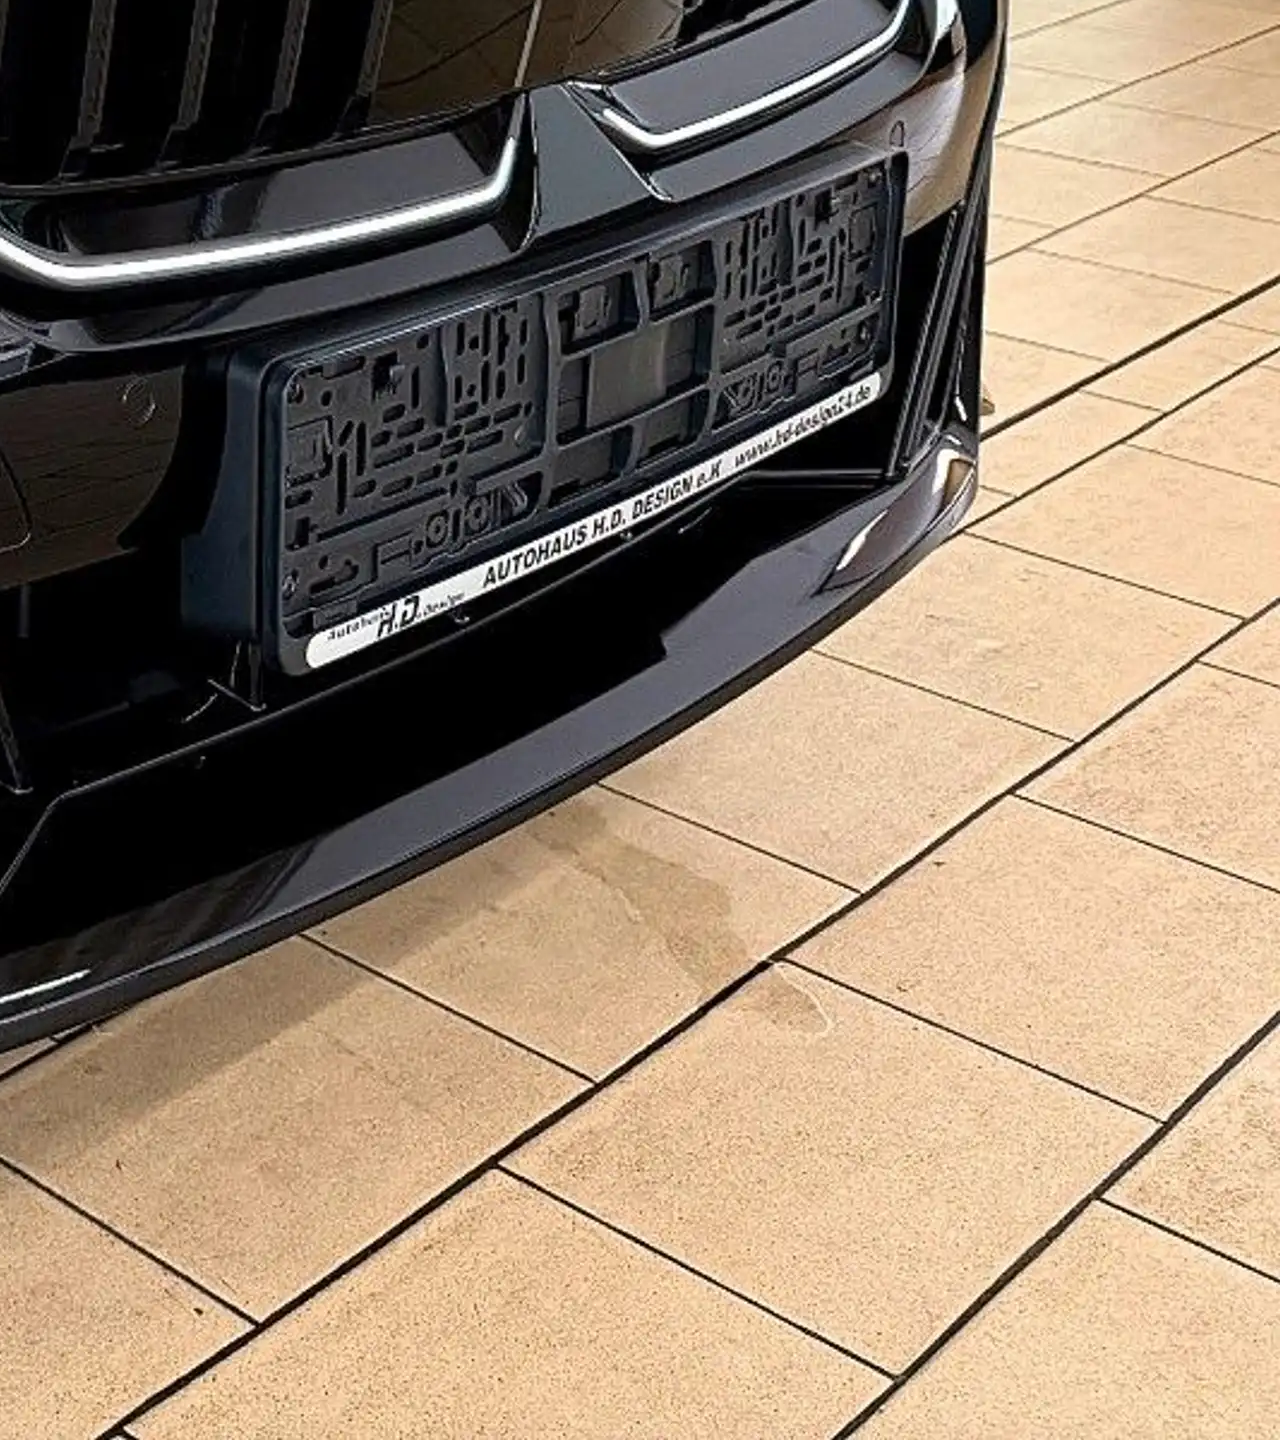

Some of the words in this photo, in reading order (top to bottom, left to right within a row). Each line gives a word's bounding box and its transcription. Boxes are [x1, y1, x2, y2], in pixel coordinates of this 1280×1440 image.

[483, 524, 588, 588] AUTOHAUS
[591, 508, 627, 539] H.D.
[631, 474, 694, 521] DESIGN
